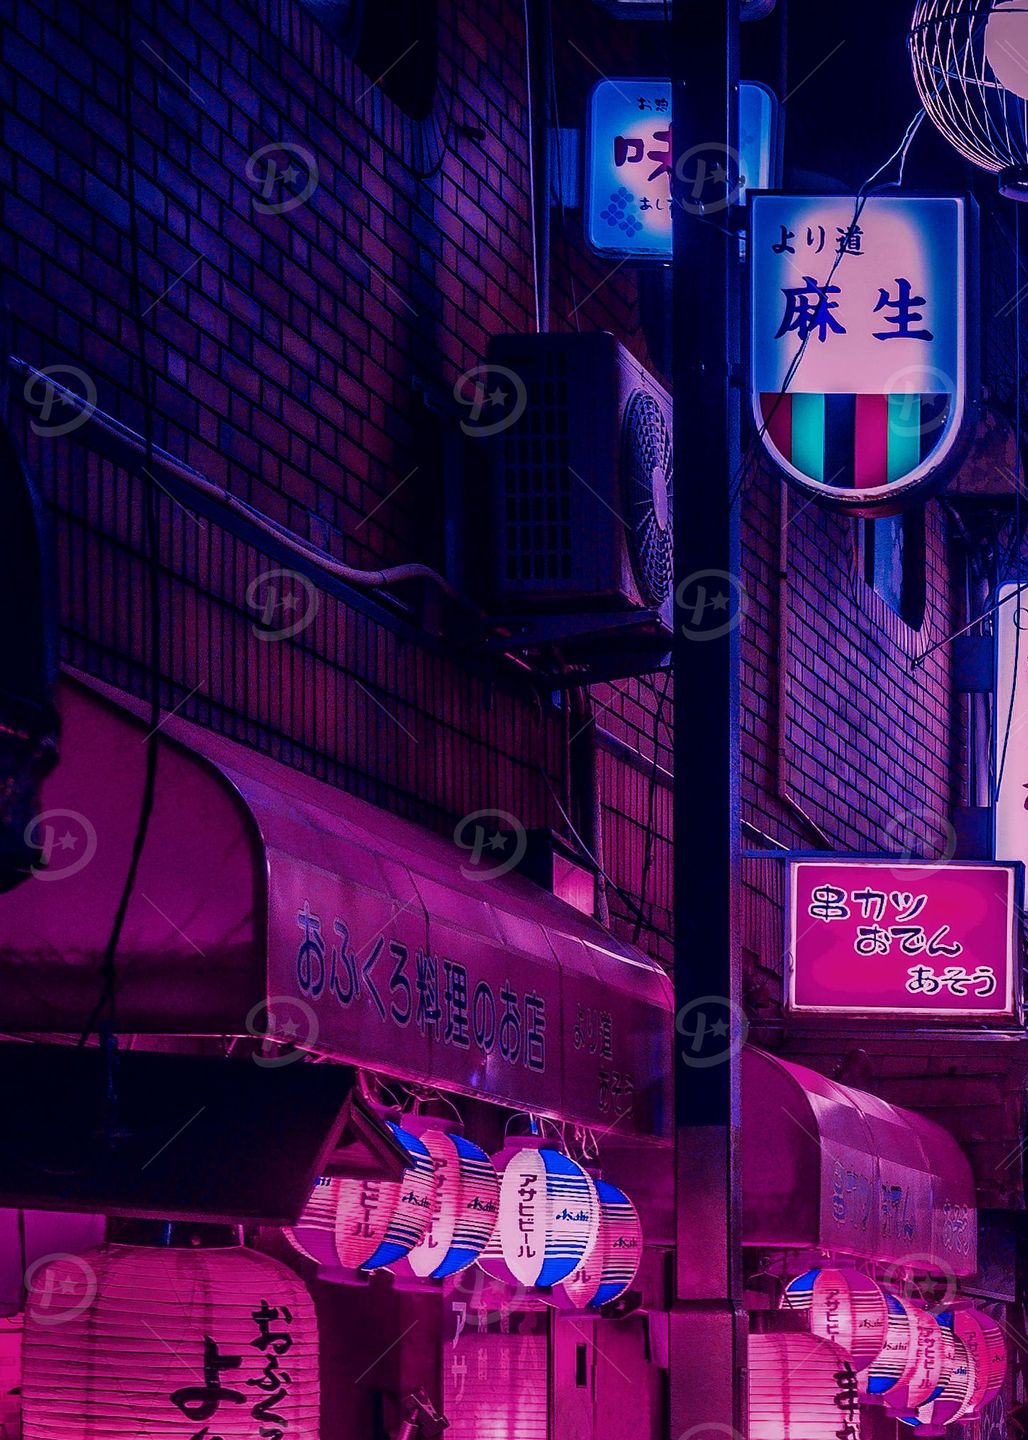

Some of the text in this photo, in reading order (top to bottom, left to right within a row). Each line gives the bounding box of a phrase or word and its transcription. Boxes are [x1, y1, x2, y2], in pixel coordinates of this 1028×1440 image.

[771, 224, 864, 256] より道
[774, 276, 934, 343] 麻生
[807, 884, 928, 922] 串カツ
[855, 926, 963, 955] おでん
[296, 900, 548, 1074] おふくろ料理のお店
[906, 966, 997, 995] あそう
[517, 1173, 536, 1259] アサヒビール
